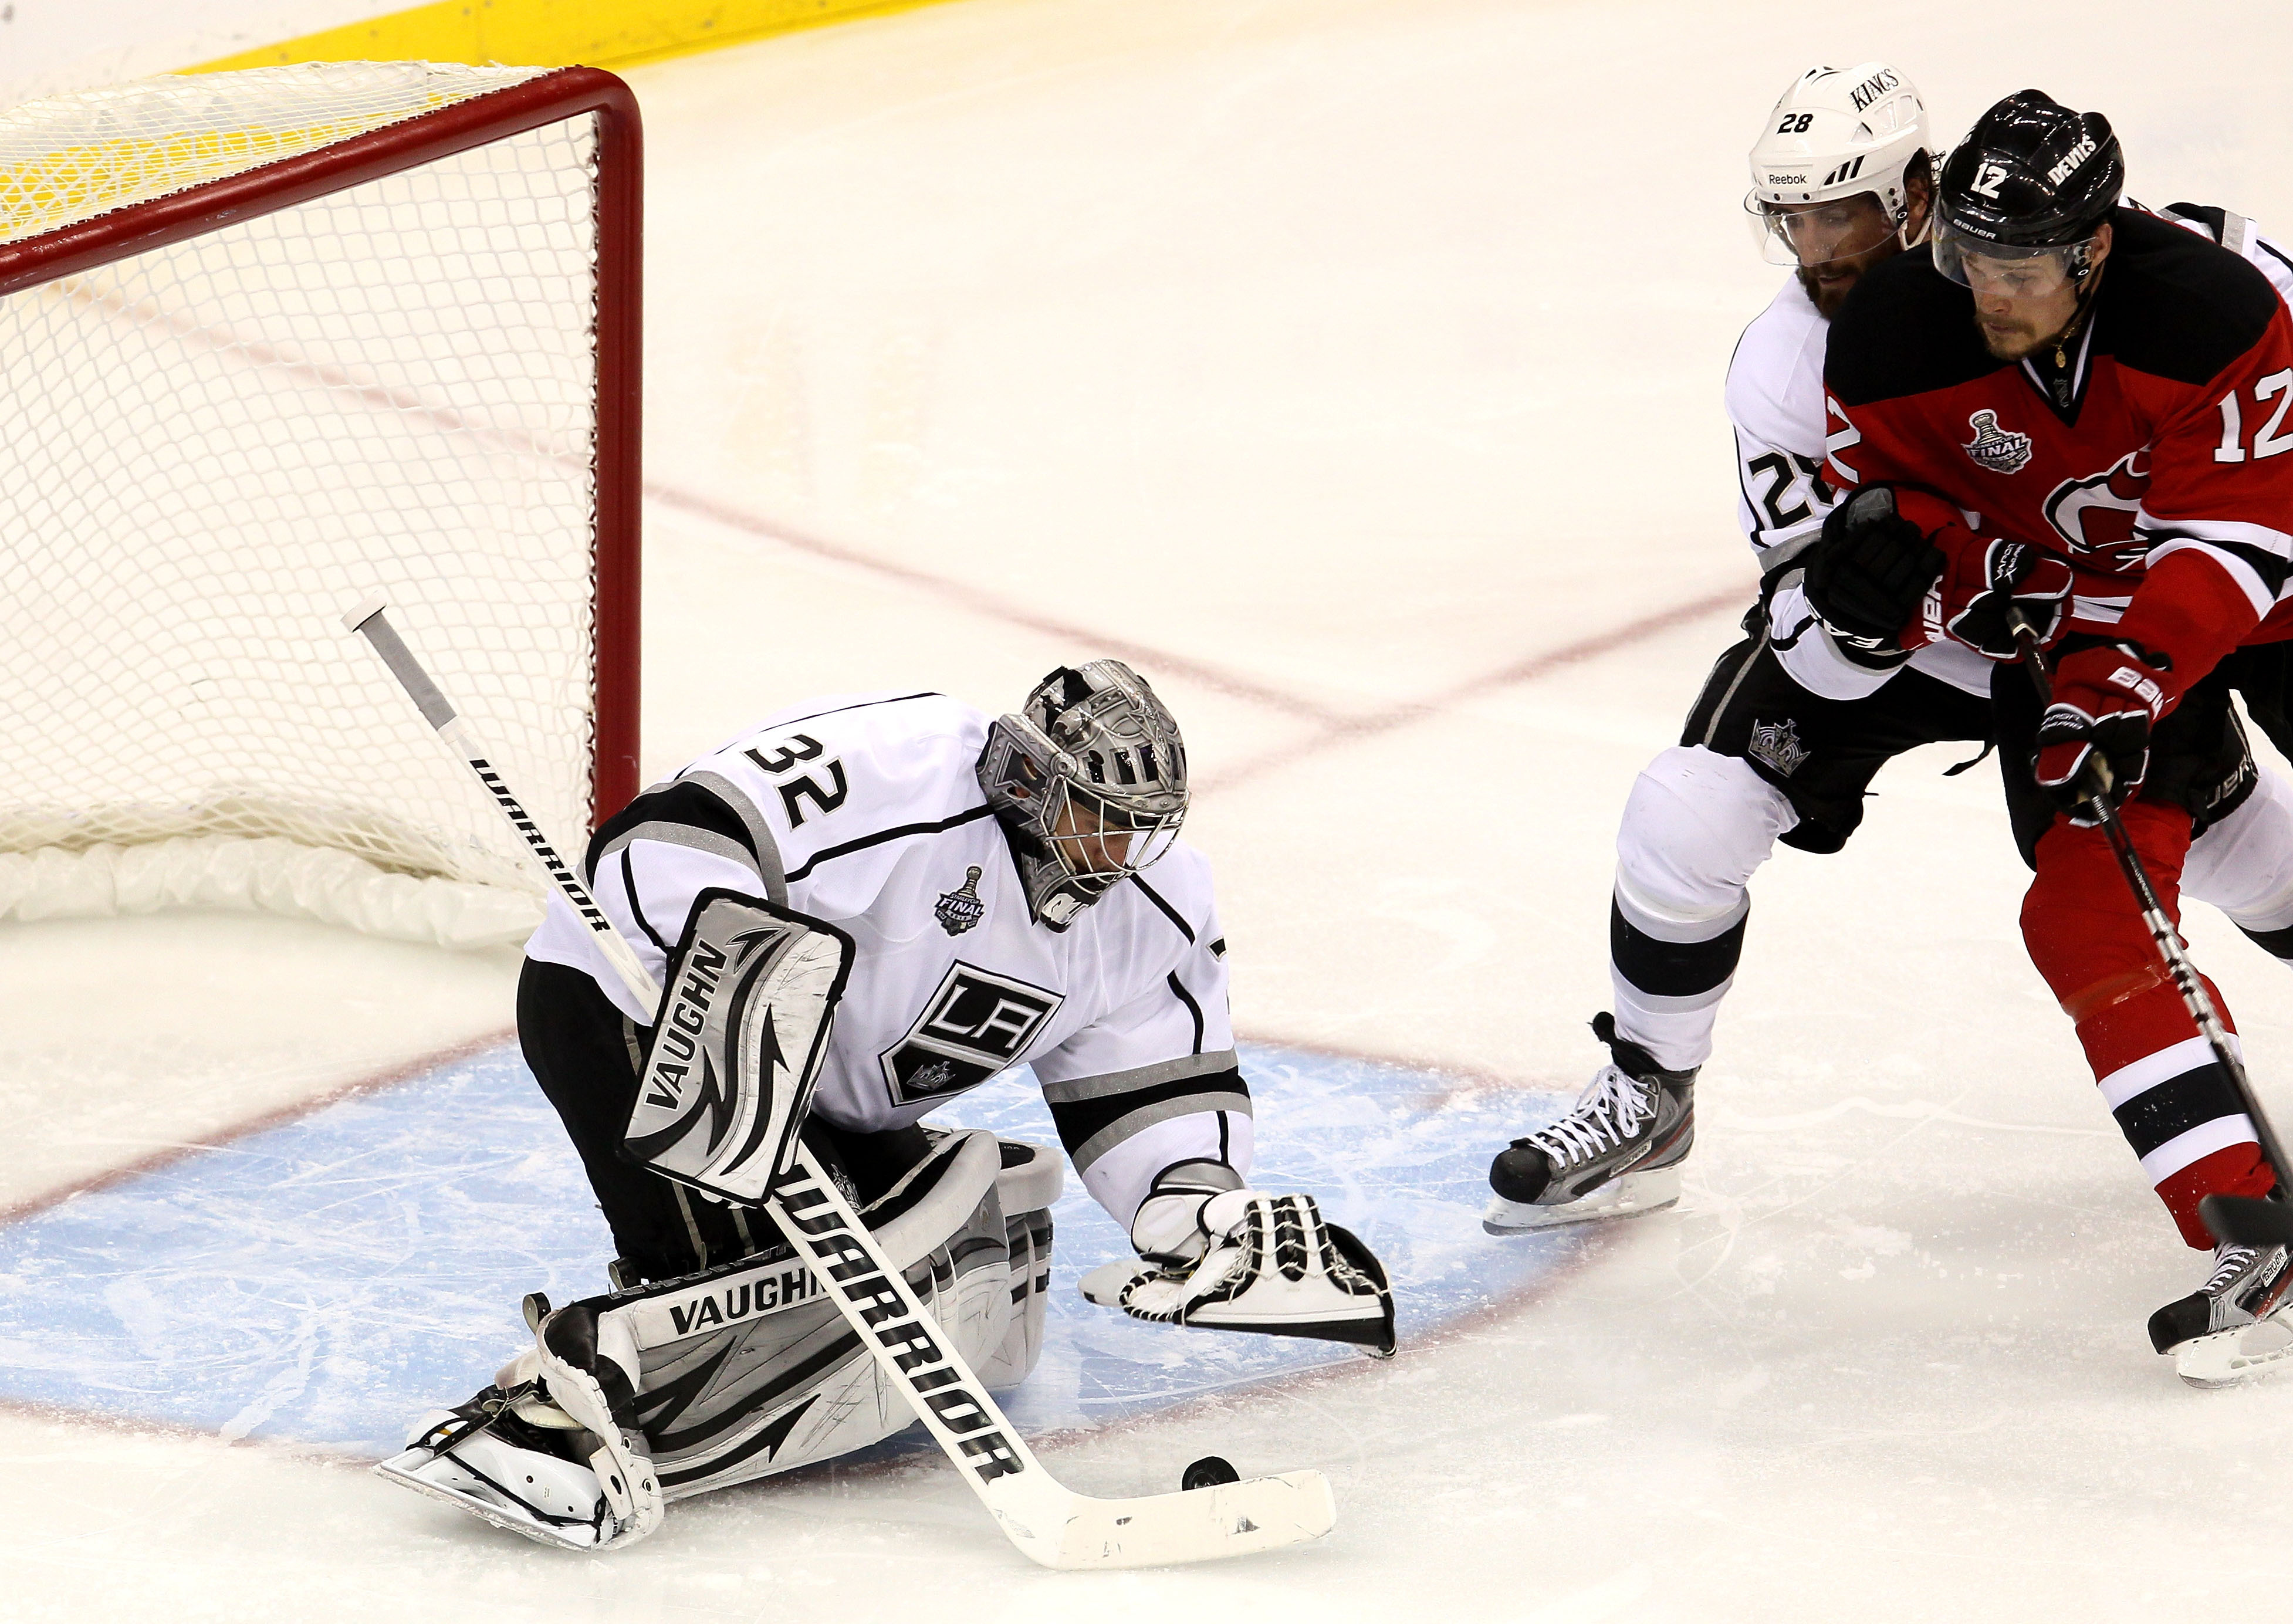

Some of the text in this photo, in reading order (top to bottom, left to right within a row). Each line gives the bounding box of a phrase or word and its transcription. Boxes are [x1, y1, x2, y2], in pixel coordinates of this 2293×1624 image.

[1849, 69, 1899, 113] KINGS
[1777, 114, 1814, 134] 28
[1769, 174, 1807, 185] Reebok
[1970, 162, 2007, 199] 12
[2047, 134, 2096, 186] DEVILS
[1953, 218, 1997, 240] BAUER
[2214, 367, 2293, 462] 12
[1971, 439, 2025, 456] FINAL
[739, 733, 850, 833] 32
[469, 759, 611, 932] WARRIOR
[939, 898, 983, 916] FINAL
[643, 938, 728, 1111] VAUGHN
[928, 984, 1043, 1050] LA
[774, 1163, 1024, 1486] WARRIOR
